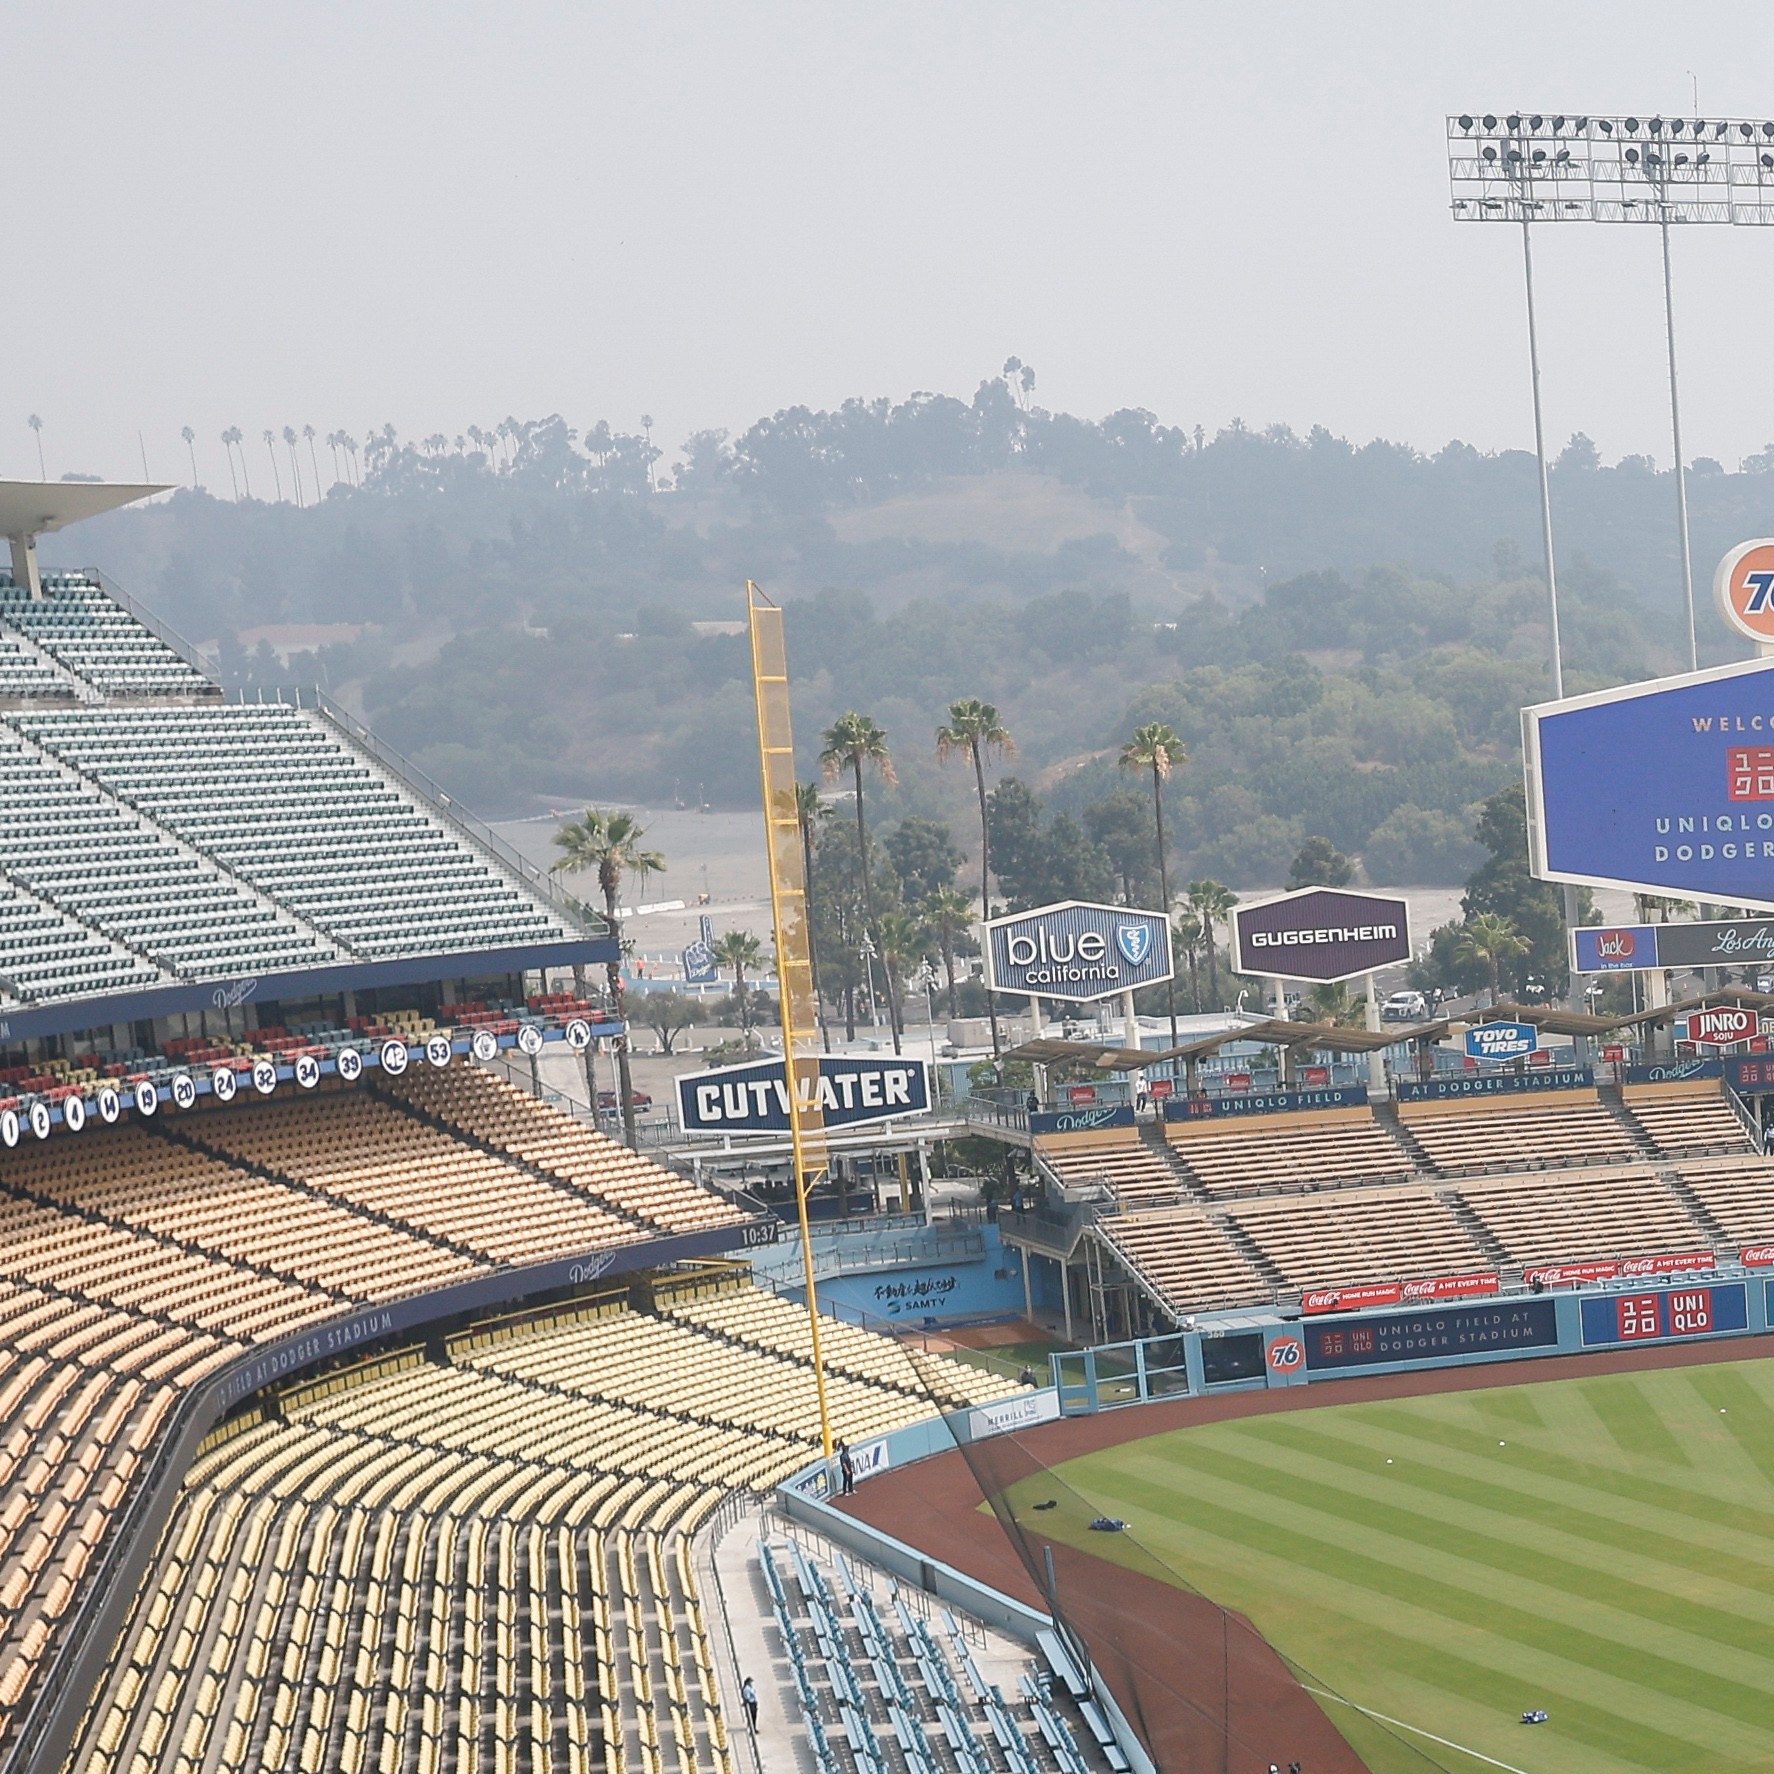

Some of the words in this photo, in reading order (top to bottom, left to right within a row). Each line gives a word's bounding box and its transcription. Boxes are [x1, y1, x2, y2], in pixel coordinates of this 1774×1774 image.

[1655, 813, 1774, 834] UNIQLO
[1007, 925, 1106, 966] blue
[1251, 925, 1397, 948] GUGGENHEIM
[1598, 932, 1633, 958] Jack
[1711, 929, 1742, 954] Los
[1026, 962, 1119, 985] california
[1698, 1012, 1748, 1033] JINRO
[1473, 1028, 1518, 1042] TOYO
[1713, 1031, 1734, 1041] SOJU
[430, 1043, 448, 1060] 53
[1480, 1039, 1529, 1053] TIRES
[299, 1063, 317, 1081] 34
[340, 1056, 359, 1073] 39
[217, 1075, 234, 1092] 24
[256, 1069, 273, 1087] 32
[1412, 1085, 1429, 1095] AT
[1438, 1078, 1503, 1093] DODGER
[1513, 1073, 1585, 1087] STADIUM
[696, 1069, 911, 1122] CUTWATER
[1222, 1097, 1287, 1111] UNIQLO
[1298, 1092, 1343, 1105] FIELD
[741, 1225, 775, 1246] 10:37
[1457, 1279, 1479, 1288] EVERY
[1480, 1277, 1497, 1285] TIME
[906, 1298, 946, 1310] SAMTY
[1673, 1295, 1704, 1312] UNI
[1379, 1321, 1445, 1337] UNIQLO
[1456, 1315, 1501, 1329] FIELD
[1511, 1312, 1529, 1324] AT
[1674, 1313, 1707, 1332] QLO
[1380, 1336, 1449, 1352] DODGER
[1459, 1328, 1534, 1344] STADIUM
[1271, 1343, 1300, 1367] 76
